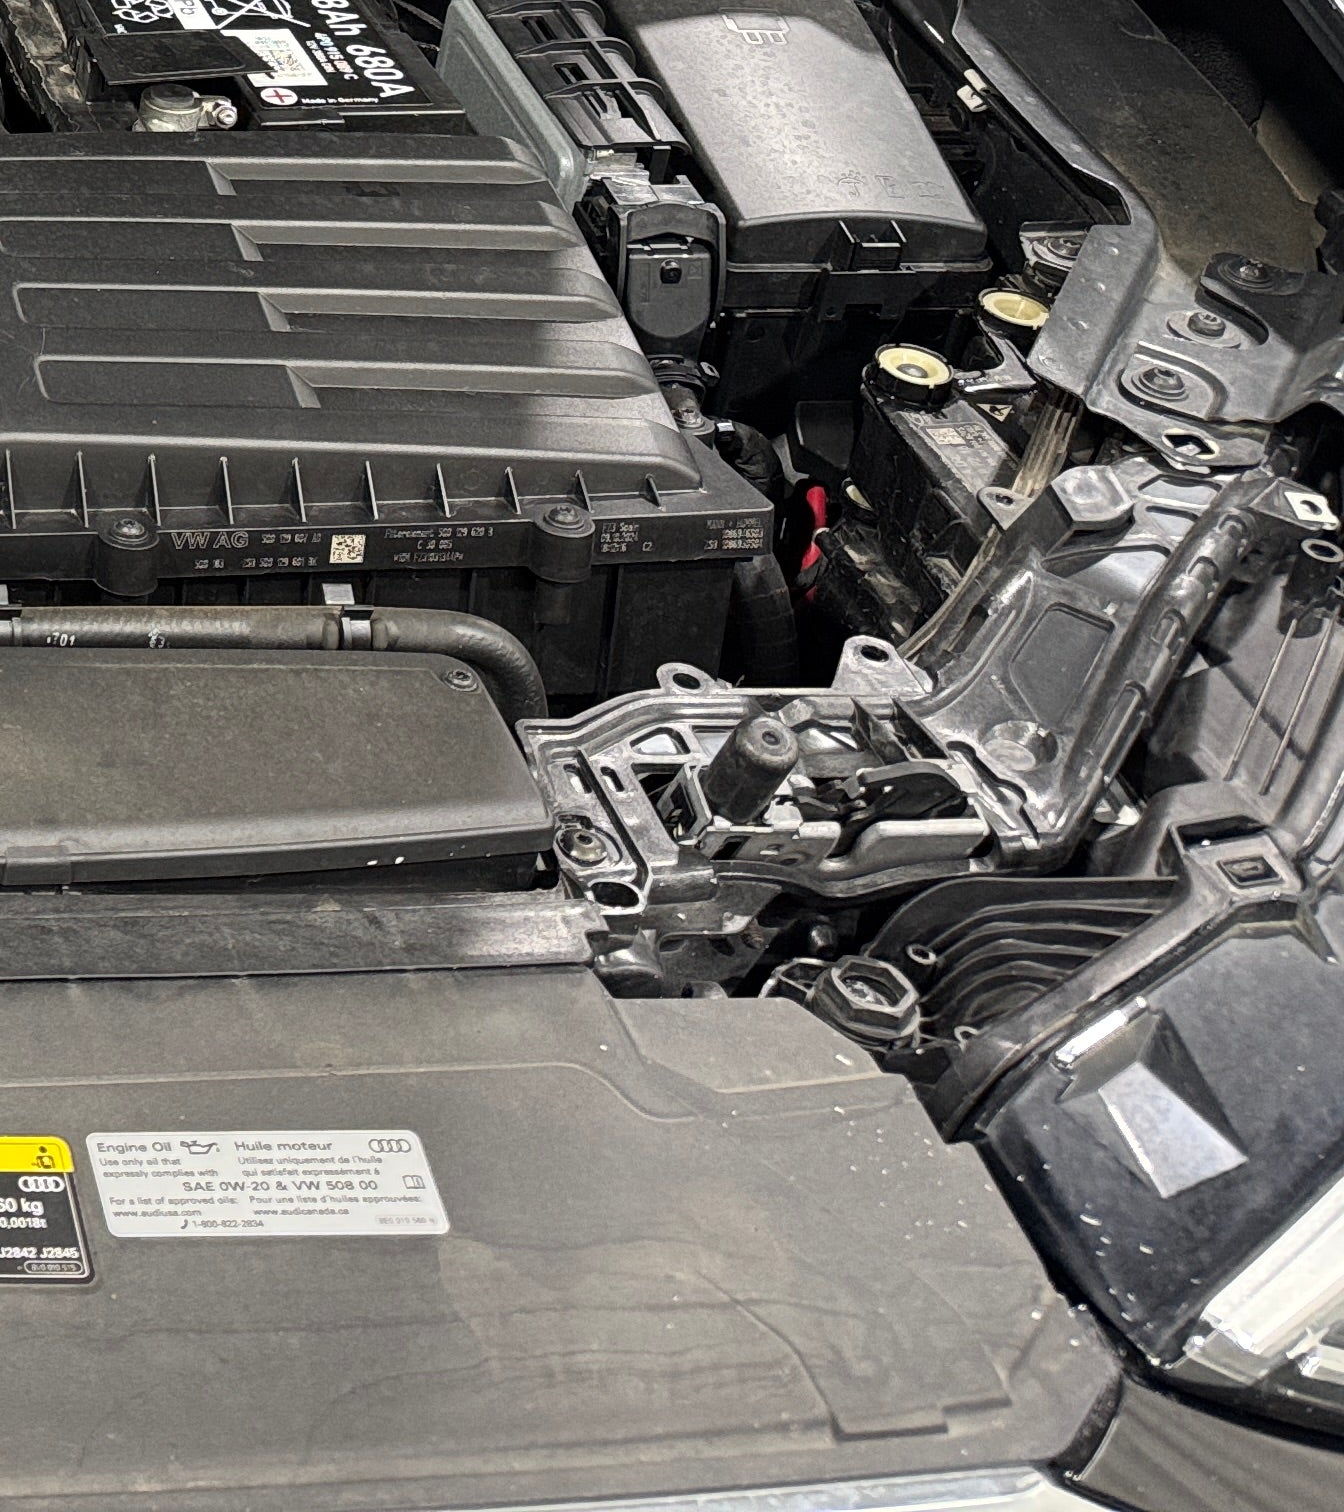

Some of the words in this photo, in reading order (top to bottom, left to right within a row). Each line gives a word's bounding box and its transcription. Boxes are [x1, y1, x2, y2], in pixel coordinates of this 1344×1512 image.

[174, 0, 195, 15] Pb
[346, 45, 414, 98] 680A
[171, 533, 211, 549] VW
[213, 531, 249, 548] AG
[418, 540, 422, 549] C
[97, 1143, 148, 1154] Engine
[152, 1142, 172, 1152] Oil
[235, 1142, 272, 1151] Huile
[277, 1142, 332, 1151] moteur
[99, 1158, 119, 1166] Use
[122, 1158, 143, 1167] only
[147, 1158, 158, 1166] oil
[161, 1158, 181, 1166] that
[239, 1157, 274, 1165] Utilisez
[276, 1157, 335, 1165] uniquement
[338, 1156, 350, 1164] de
[352, 1156, 383, 1164] l'huile
[103, 1169, 148, 1179] expressly
[152, 1169, 195, 1178] complies
[197, 1169, 218, 1177] with
[242, 1168, 258, 1178] qui
[261, 1168, 299, 1176] satisfait
[182, 1181, 215, 1191] SAE
[218, 1180, 270, 1191] 0W-20
[275, 1180, 288, 1190] &
[292, 1180, 320, 1190] VW
[326, 1180, 354, 1190] 508
[359, 1180, 378, 1190] 00
[110, 1197, 125, 1205] For
[138, 1197, 152, 1205] list
[155, 1197, 164, 1205] of
[168, 1196, 214, 1206] approved
[249, 1196, 272, 1204] Pour
[20, 1197, 44, 1215] kg
[112, 1209, 202, 1217] www.audiusa.com
[254, 1208, 350, 1216] www.audicanada.ca
[0, 1217, 47, 1229] 0,0018t
[193, 1220, 264, 1228] 1-800-822-2834
[40, 1246, 80, 1258] J2845
